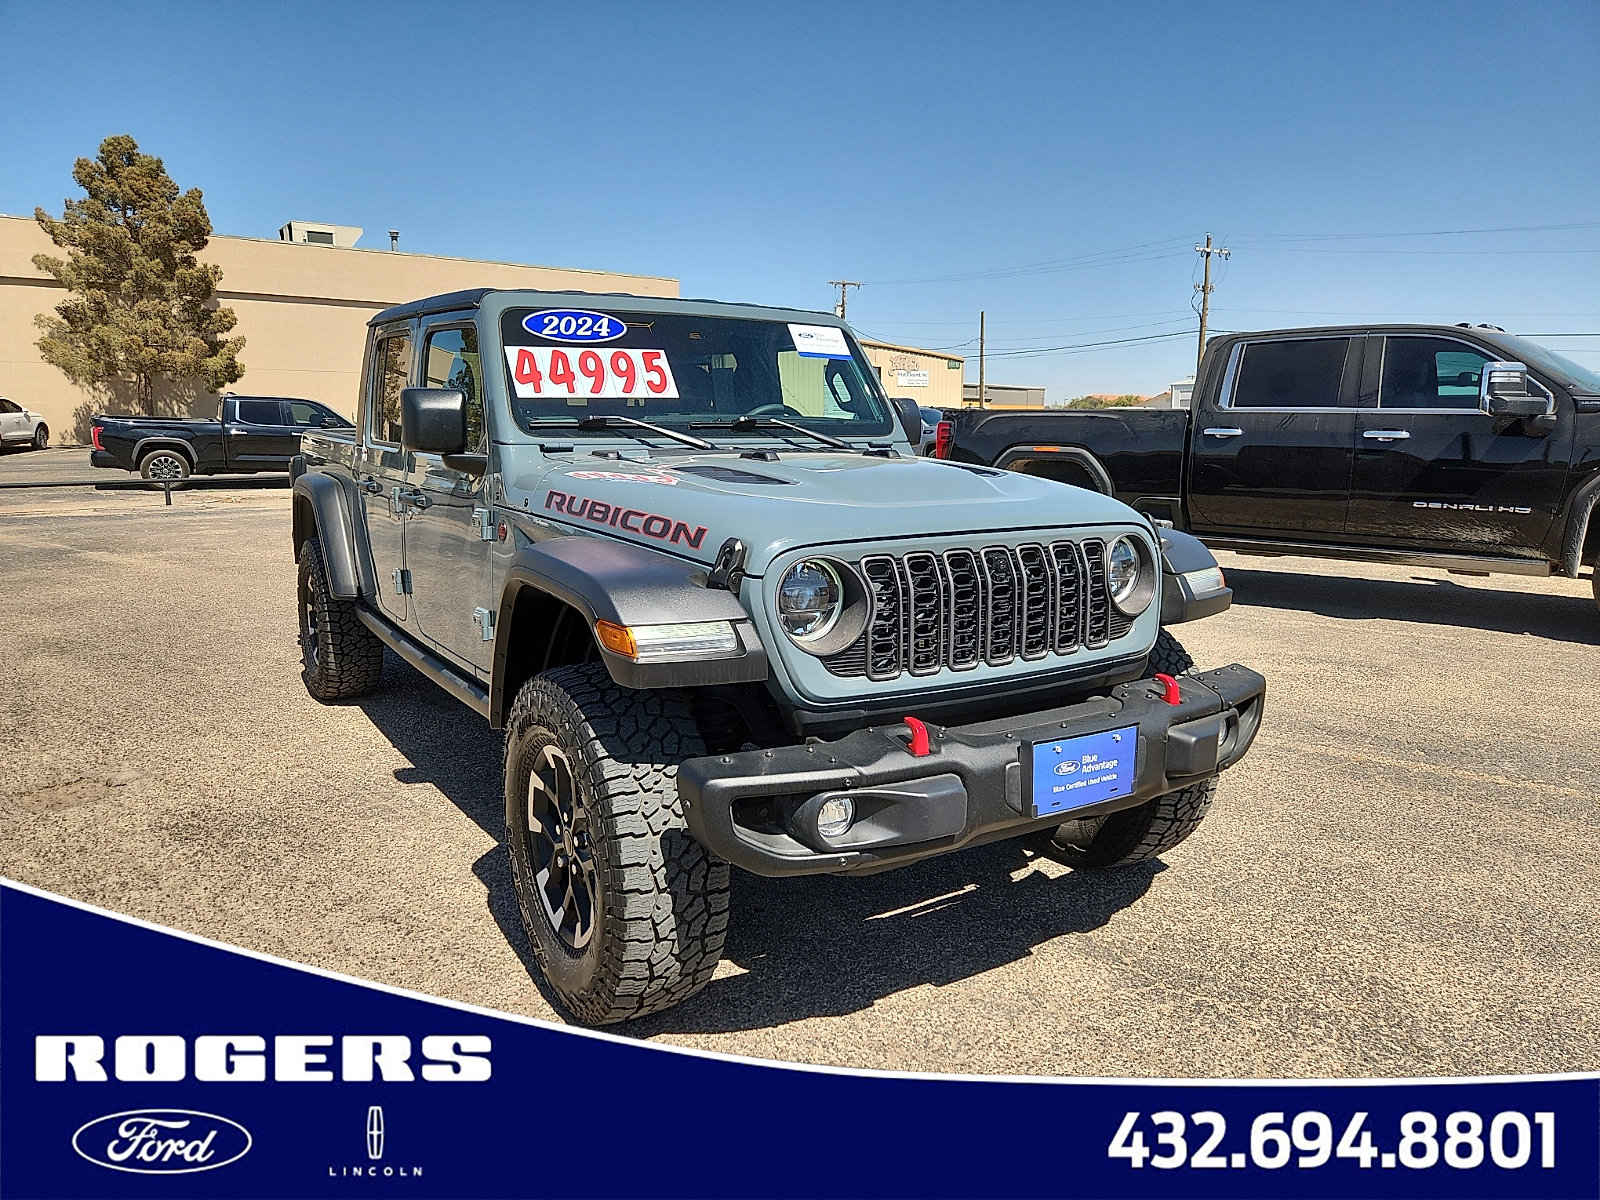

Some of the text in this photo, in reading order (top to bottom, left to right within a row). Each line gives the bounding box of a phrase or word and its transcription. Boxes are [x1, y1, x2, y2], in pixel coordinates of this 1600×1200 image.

[541, 315, 610, 337] 2024
[514, 348, 667, 394] 44995
[1412, 501, 1532, 514] DENALI HD
[544, 489, 709, 550] RUBICON
[1081, 754, 1098, 764] Blue
[1081, 759, 1118, 775] Advantage
[1052, 773, 1118, 794] Blue Certified Used Vehicle
